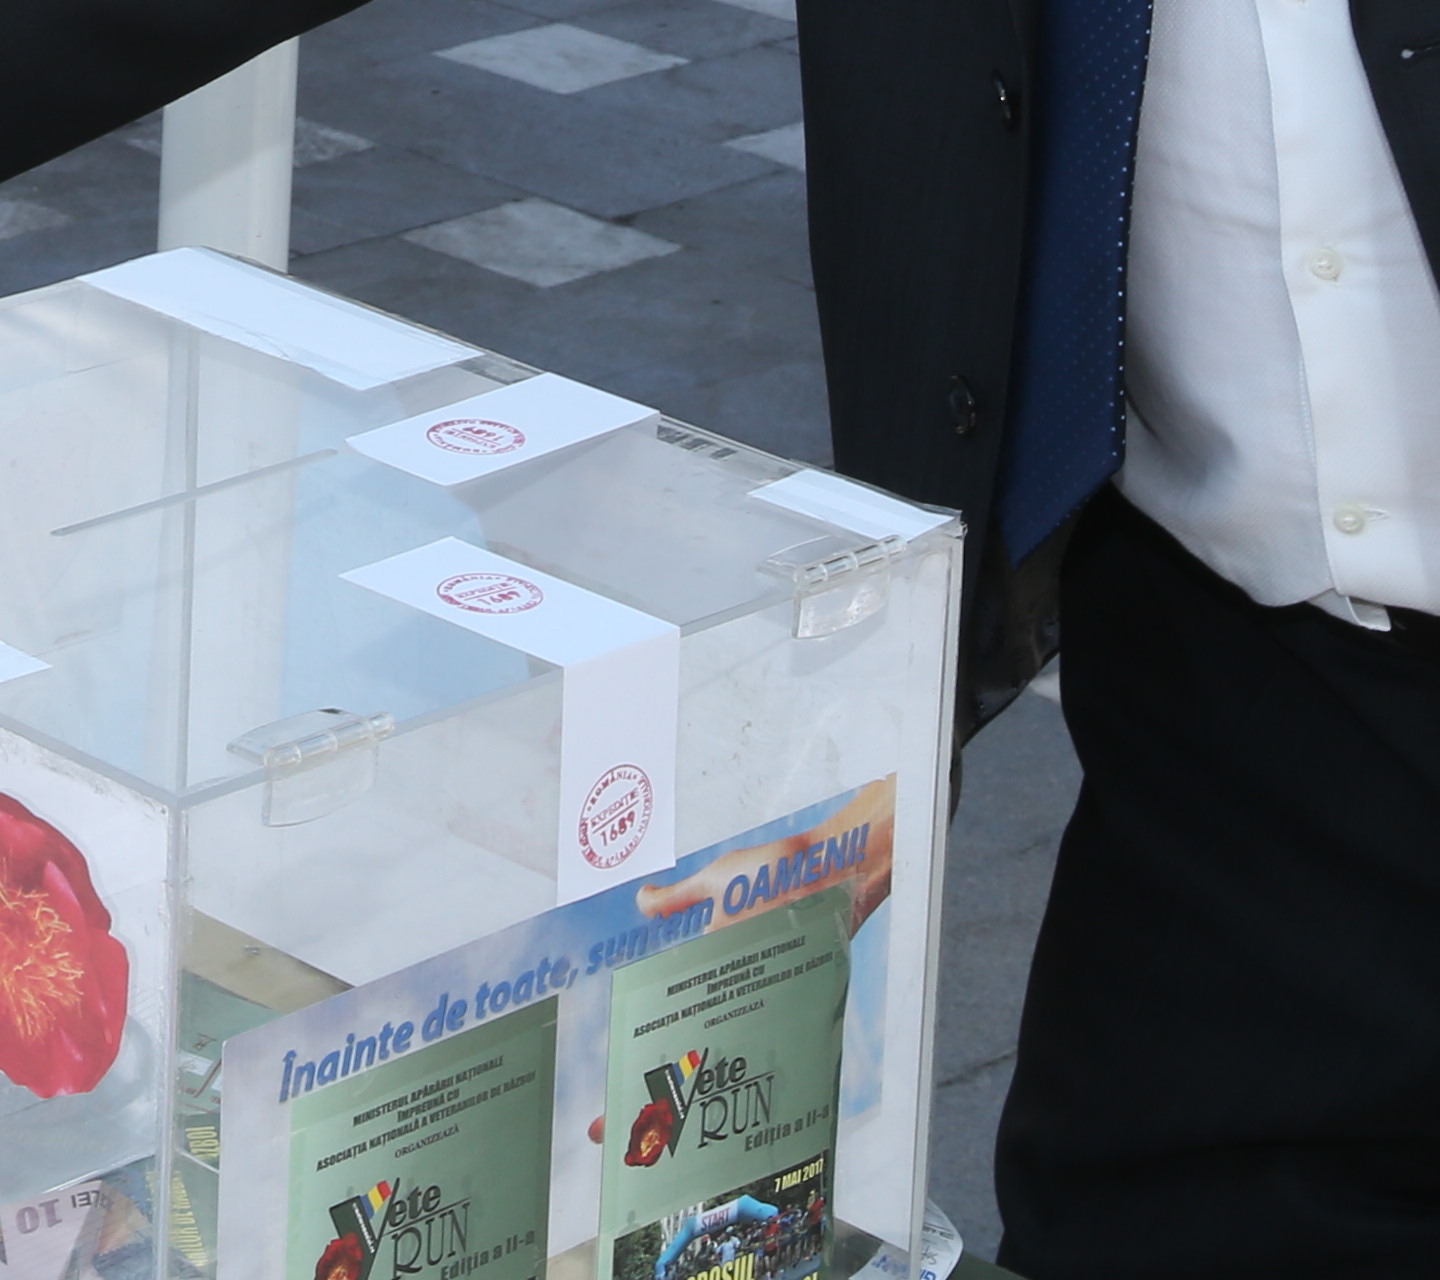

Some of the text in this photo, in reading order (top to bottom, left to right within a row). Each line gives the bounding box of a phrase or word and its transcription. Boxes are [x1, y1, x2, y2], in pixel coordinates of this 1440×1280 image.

[278, 823, 870, 1103] Înainte de toate, suntem OAMENI!
[752, 964, 765, 979] CU
[667, 968, 720, 997] MINISTERUL
[353, 1095, 410, 1127] MINISTERUL
[697, 1074, 776, 1149] RUN
[793, 1118, 803, 1134] a
[774, 1158, 825, 1193] 7 MAI 2017
[15, 1190, 100, 1234] LEI 10
[701, 1206, 731, 1232] START
[391, 1202, 471, 1280] RUN
[492, 1242, 502, 1261] a
